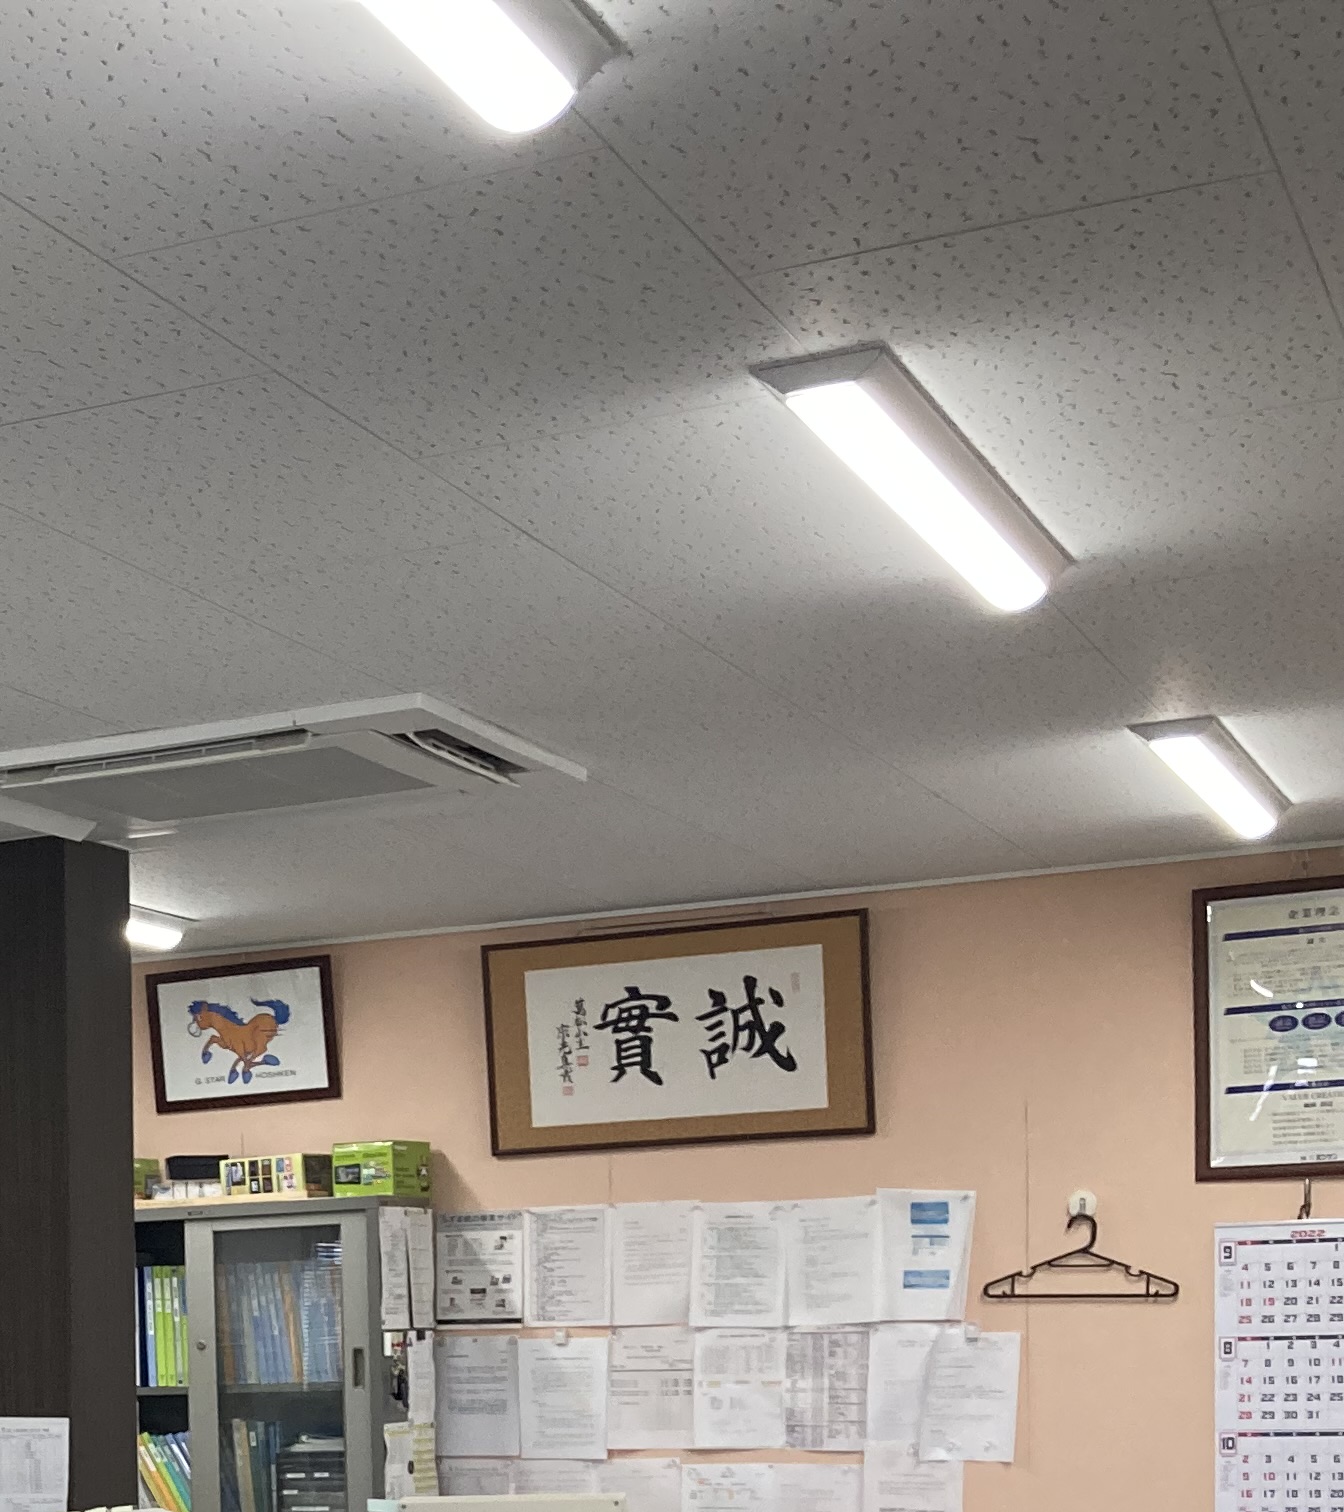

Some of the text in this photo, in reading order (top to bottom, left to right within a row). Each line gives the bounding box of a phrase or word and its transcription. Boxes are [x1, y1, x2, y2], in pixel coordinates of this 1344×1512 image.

[1290, 1230, 1326, 1238] 2022
[1224, 1246, 1232, 1259] 9
[1265, 1263, 1271, 1271] 5
[1287, 1262, 1294, 1270] 6
[1333, 1261, 1339, 1269] 8
[1241, 1281, 1250, 1289] 11
[1263, 1280, 1274, 1288] 12
[1308, 1279, 1320, 1287] 14
[1332, 1278, 1343, 1286] 15
[1241, 1298, 1252, 1306] 18
[1263, 1298, 1275, 1306] 19
[1284, 1297, 1297, 1305] 20
[1329, 1296, 1343, 1304] 22
[1261, 1315, 1275, 1323] 26
[1284, 1315, 1297, 1323] 27
[1329, 1314, 1343, 1322] 29
[1224, 1342, 1232, 1354] 8
[1311, 1341, 1317, 1349] 3
[1265, 1359, 1271, 1367] 8
[1288, 1359, 1294, 1367] 9
[1332, 1358, 1343, 1366] 11
[1241, 1377, 1252, 1385] 14
[1308, 1376, 1320, 1384] 17
[1239, 1393, 1343, 1402] 21 22 23 24 25
[1262, 1411, 1275, 1419] 29
[1284, 1411, 1297, 1419] 30
[1222, 1438, 1235, 1449] 10
[1242, 1455, 1340, 1463] 2 3 4 5 6
[1309, 1472, 1320, 1480] 12
[1332, 1472, 1343, 1480] 13
[1241, 1489, 1344, 1498] 16 17 18 19 20
